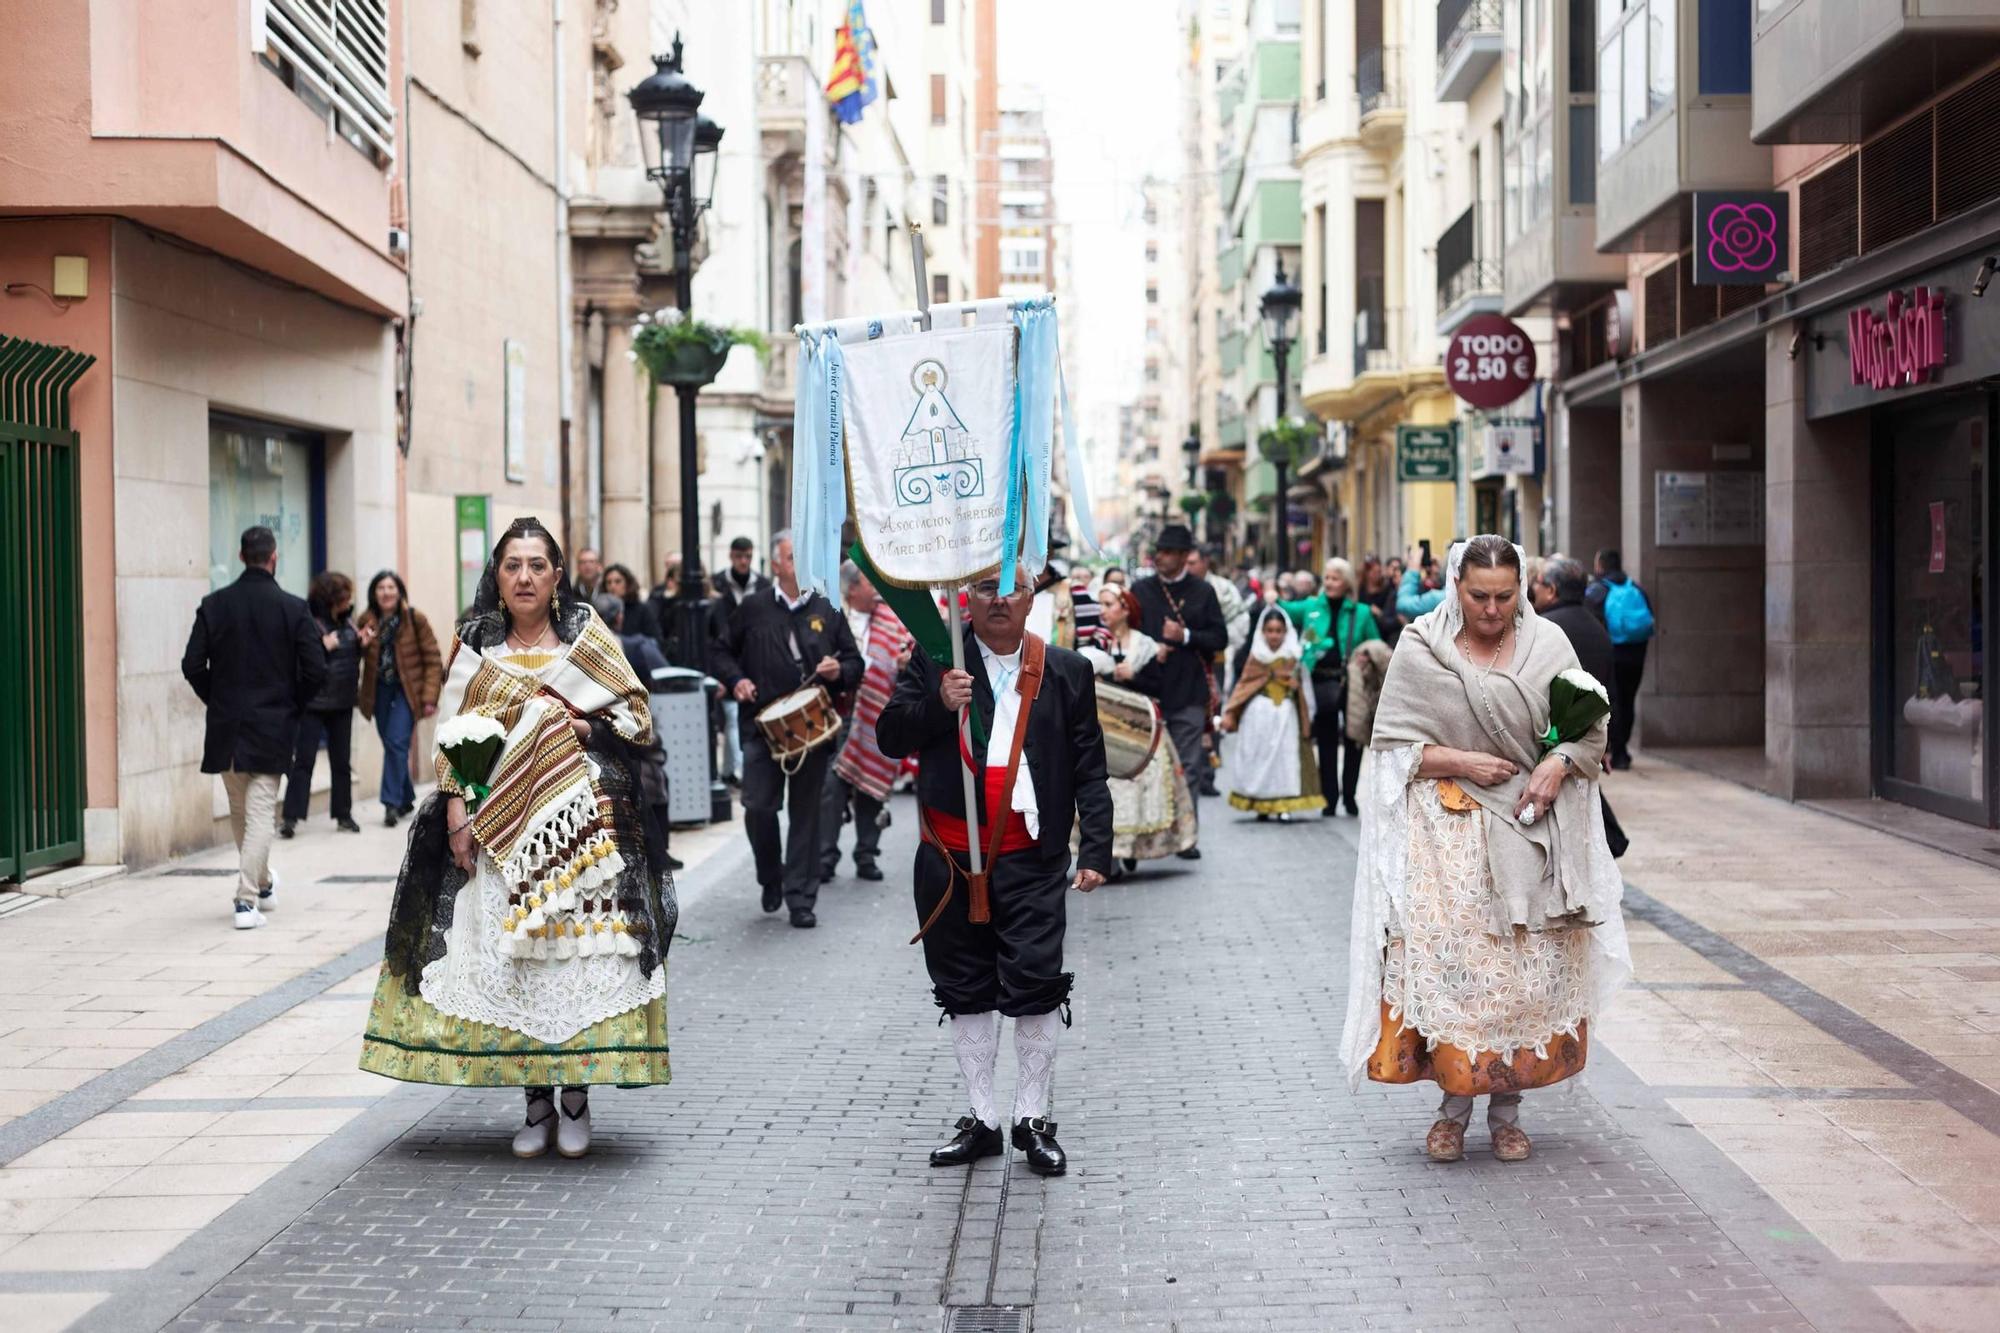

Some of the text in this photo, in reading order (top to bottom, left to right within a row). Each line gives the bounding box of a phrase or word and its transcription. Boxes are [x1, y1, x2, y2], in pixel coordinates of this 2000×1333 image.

[1454, 355, 1530, 384] 2,50 €
[1458, 334, 1524, 356] TODO
[1848, 286, 1935, 391] Miss Sushi
[829, 361, 839, 466] Javier Carratalá Palencia
